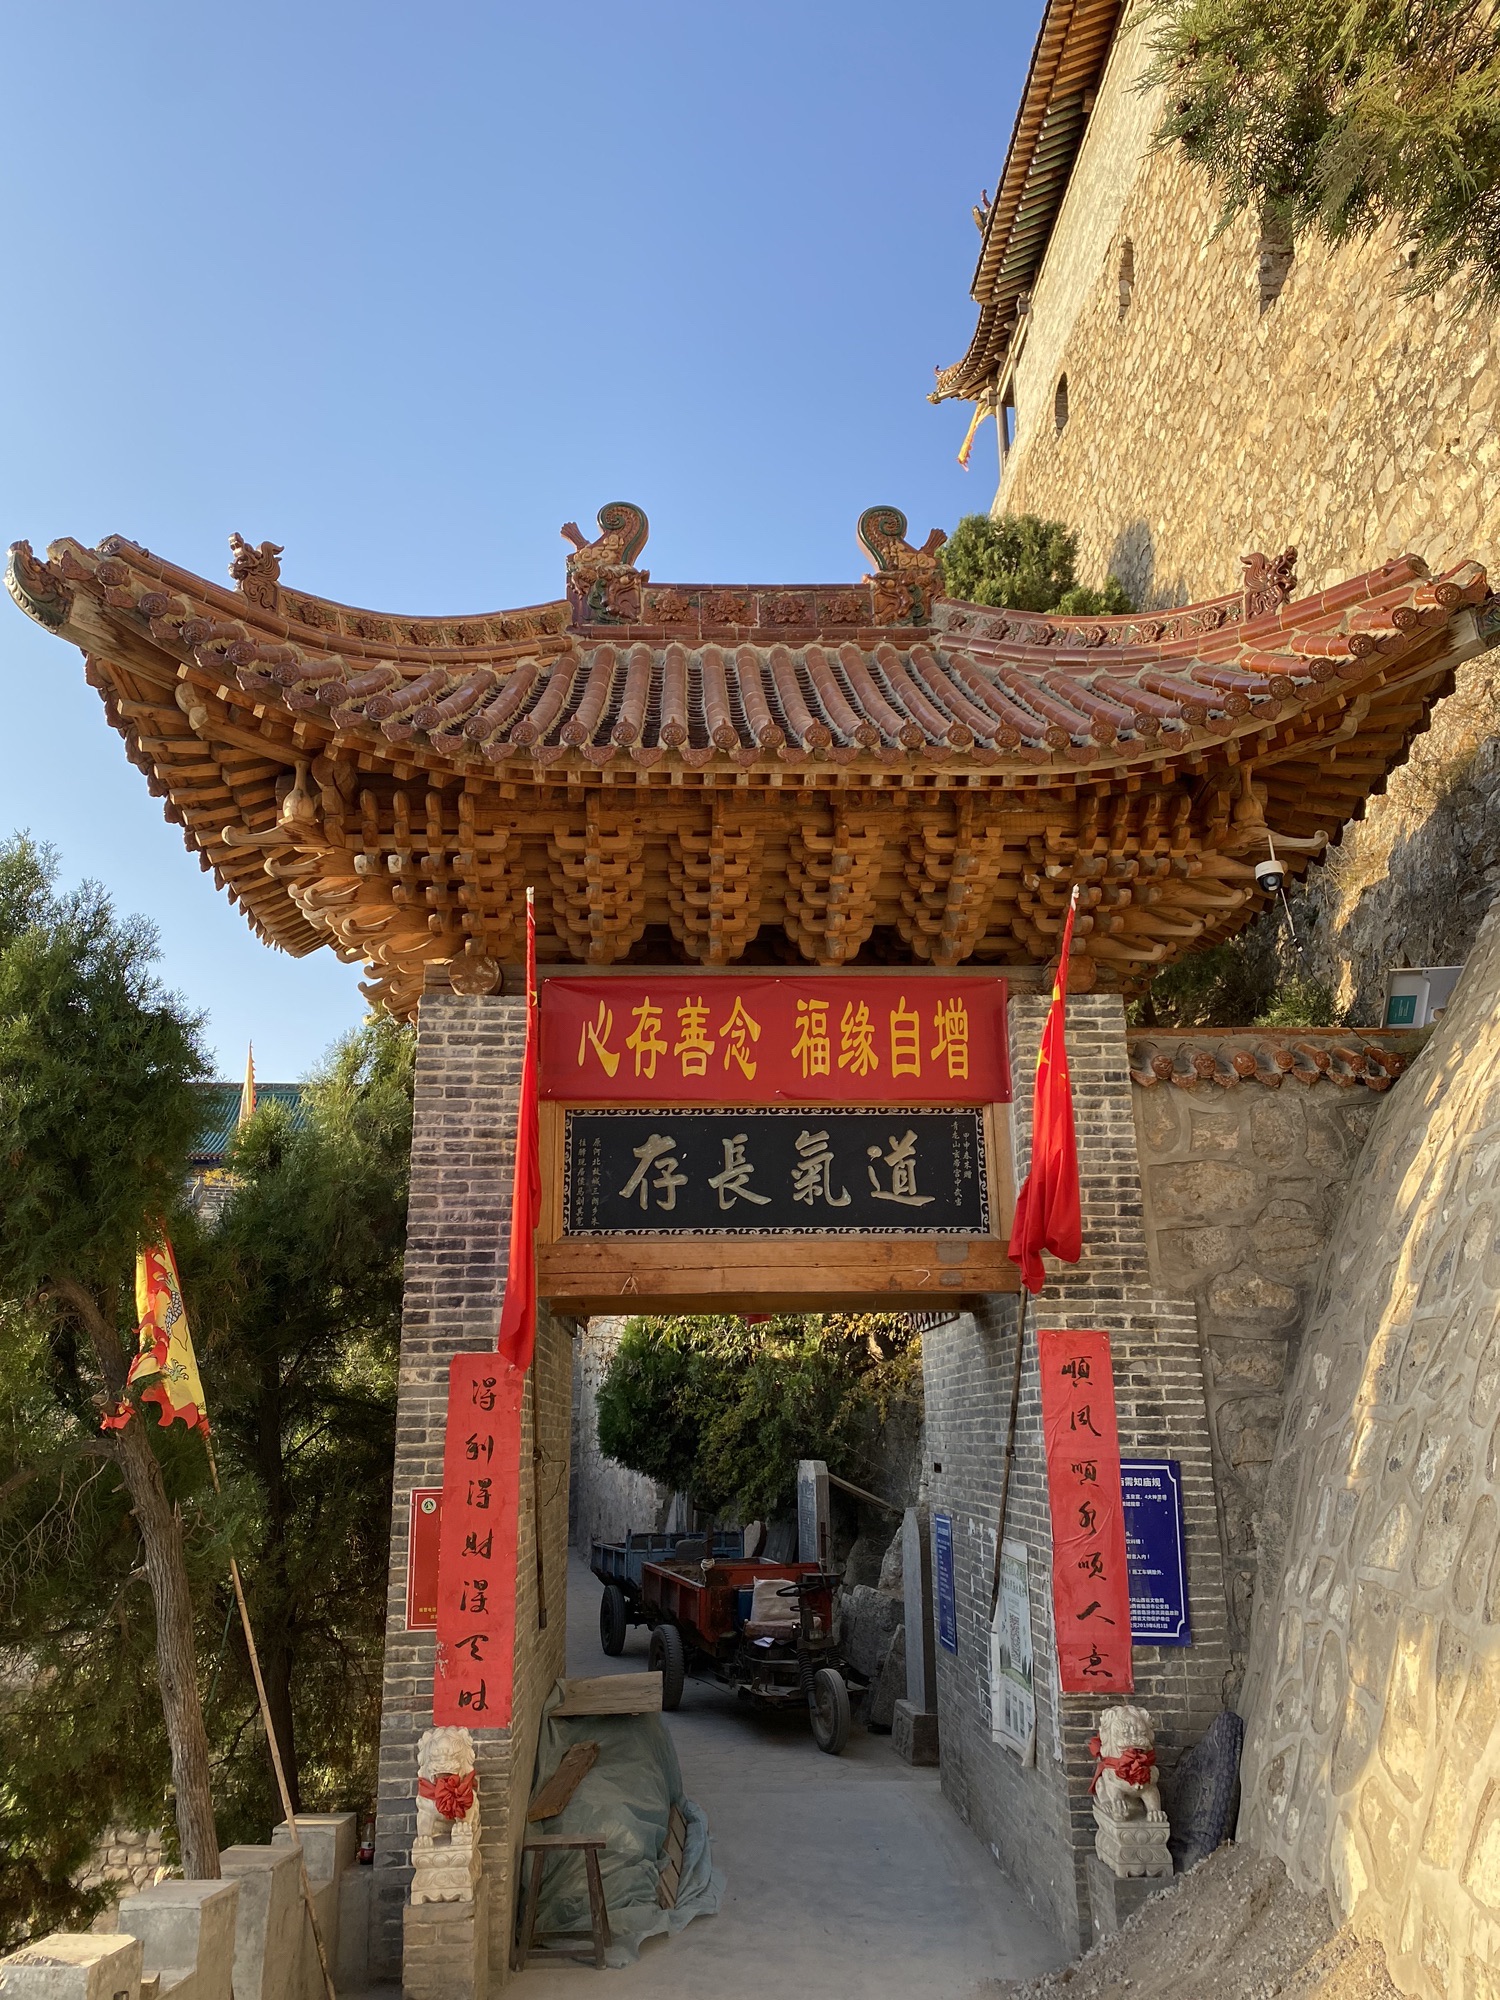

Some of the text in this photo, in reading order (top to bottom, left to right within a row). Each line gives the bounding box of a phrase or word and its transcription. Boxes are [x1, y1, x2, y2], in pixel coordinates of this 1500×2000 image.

[577, 994, 970, 1081] 心存善念 福缘自增
